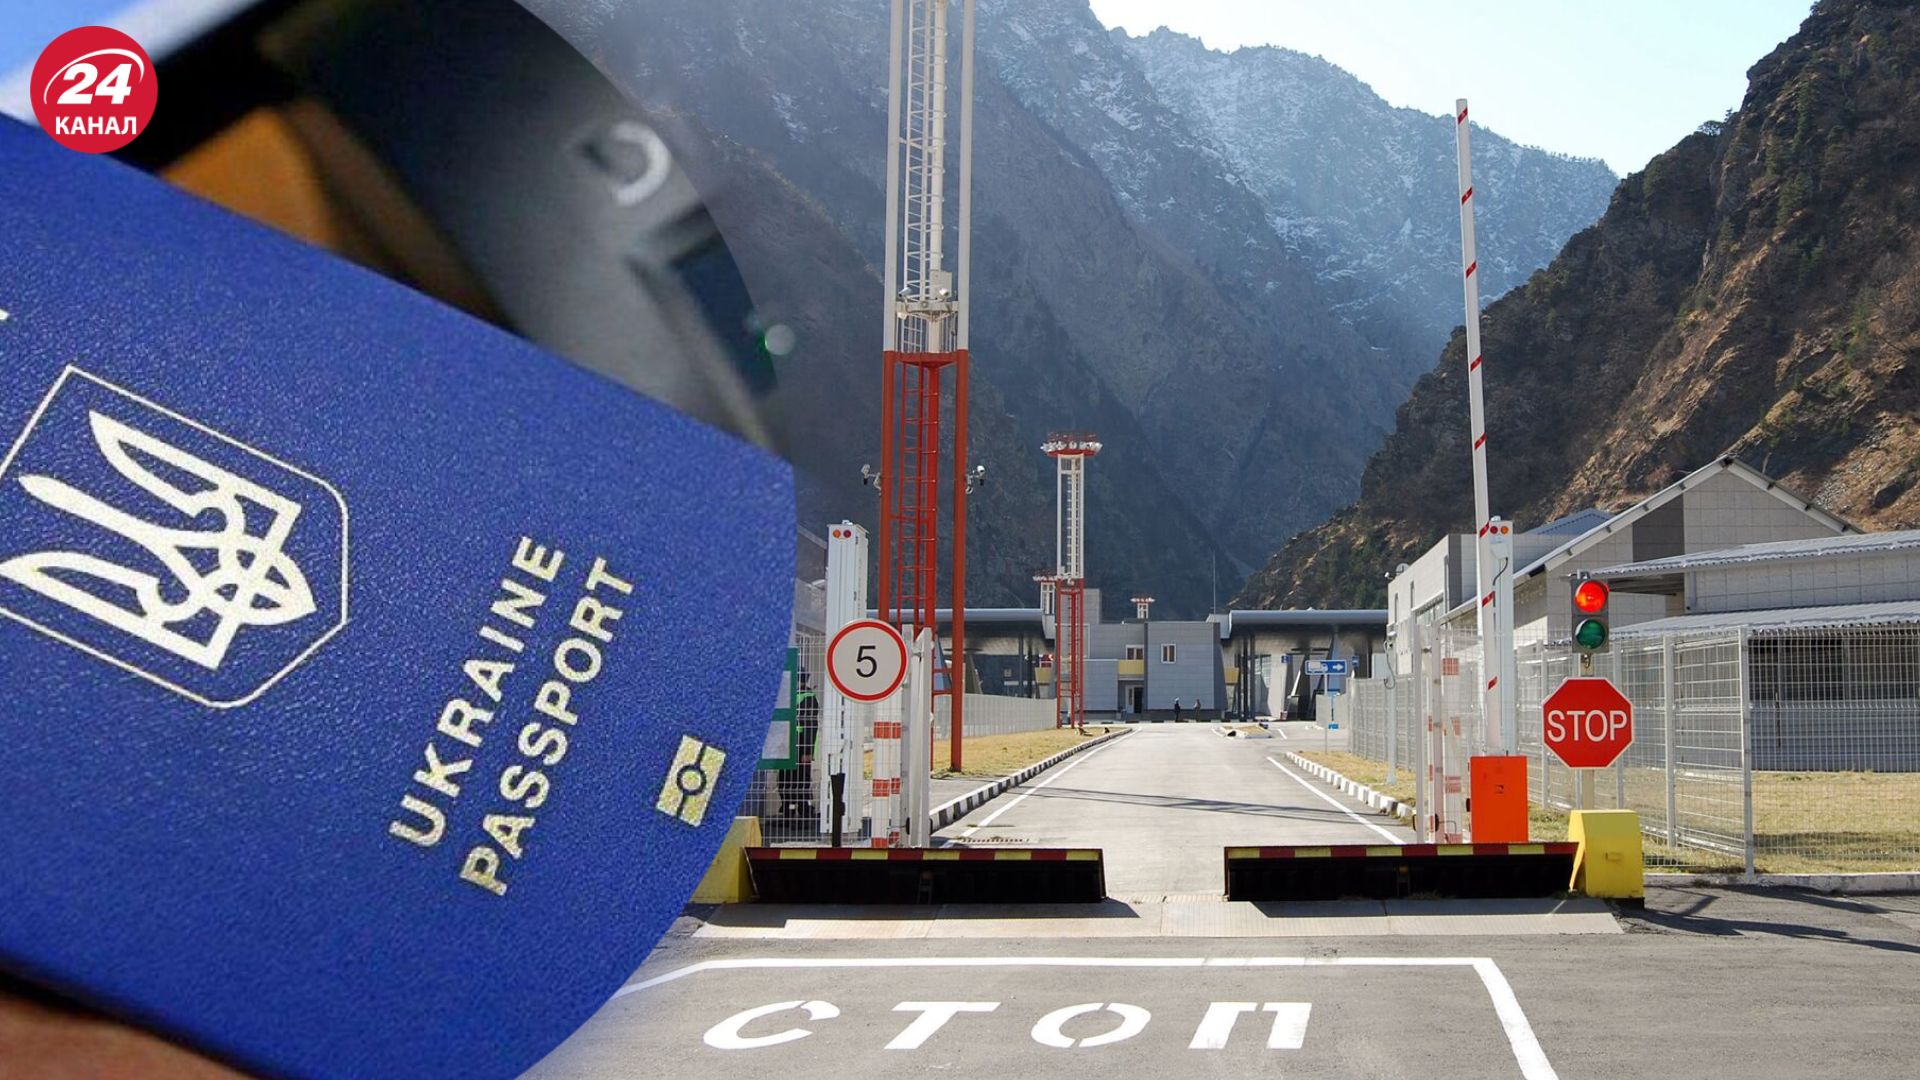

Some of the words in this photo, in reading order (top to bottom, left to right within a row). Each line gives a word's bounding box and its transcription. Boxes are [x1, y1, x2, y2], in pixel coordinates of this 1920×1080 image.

[855, 645, 878, 678] 5
[389, 536, 565, 846] UKRAINE
[460, 557, 633, 897] PASSPORT
[1546, 709, 1627, 743] STOP
[703, 1000, 1313, 1050] СТОП
